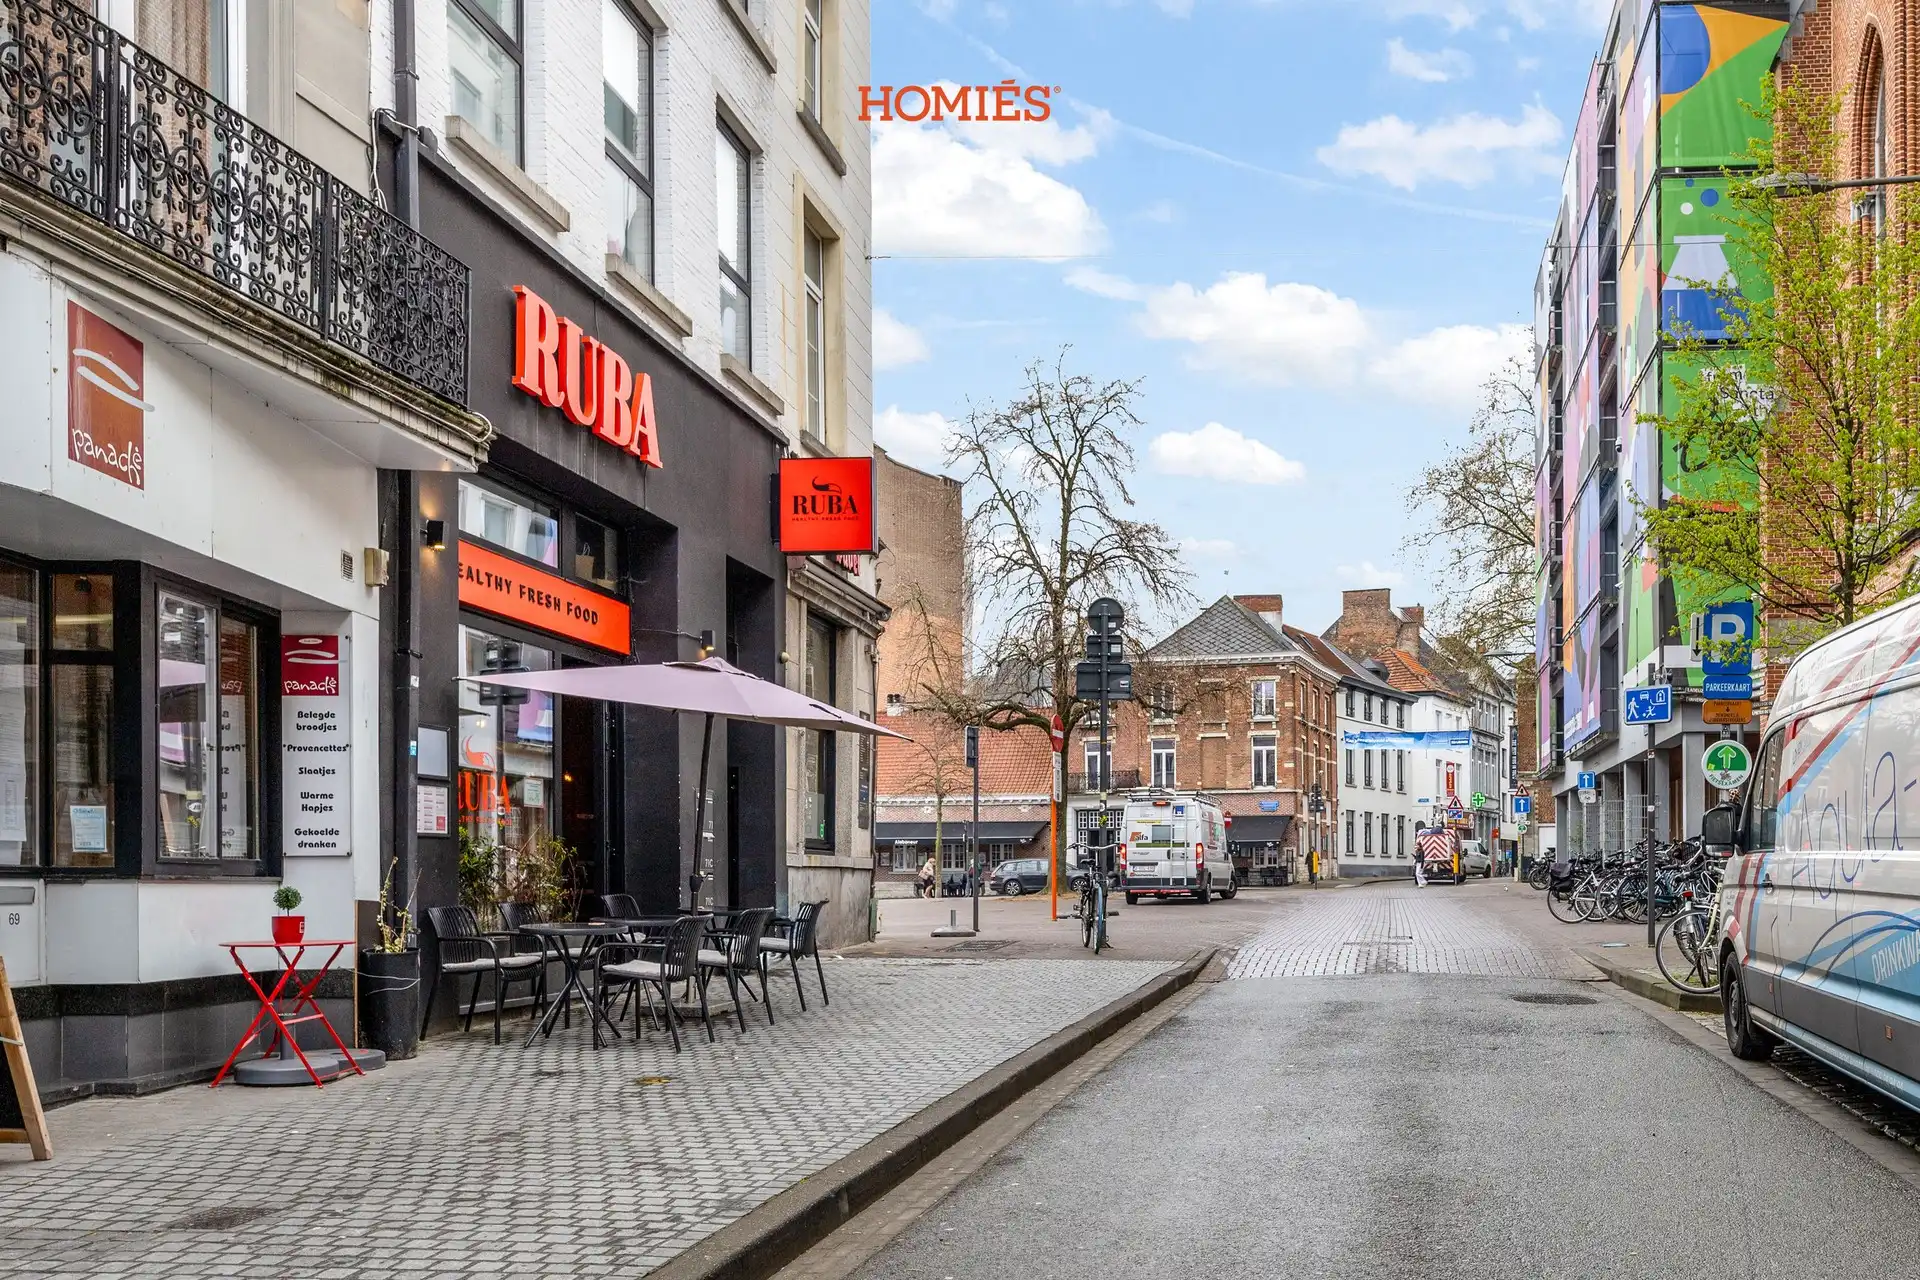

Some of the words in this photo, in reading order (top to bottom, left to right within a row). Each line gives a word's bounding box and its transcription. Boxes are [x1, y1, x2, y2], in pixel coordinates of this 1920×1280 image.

[512, 284, 663, 469] RUBA
[792, 494, 859, 515] RUBA
[519, 584, 561, 612] FRESH
[566, 601, 599, 625] FOOD
[1711, 613, 1746, 664] P
[1705, 682, 1751, 692] PARKEERKAART
[297, 710, 336, 720] Belegde
[296, 722, 337, 733] broodjes
[298, 766, 336, 776] Slaatjes
[300, 791, 334, 799] Warme
[301, 803, 334, 814] Hapjes
[294, 828, 340, 836] Gekoelde
[297, 840, 337, 848] dranken
[8, 912, 20, 926] 69
